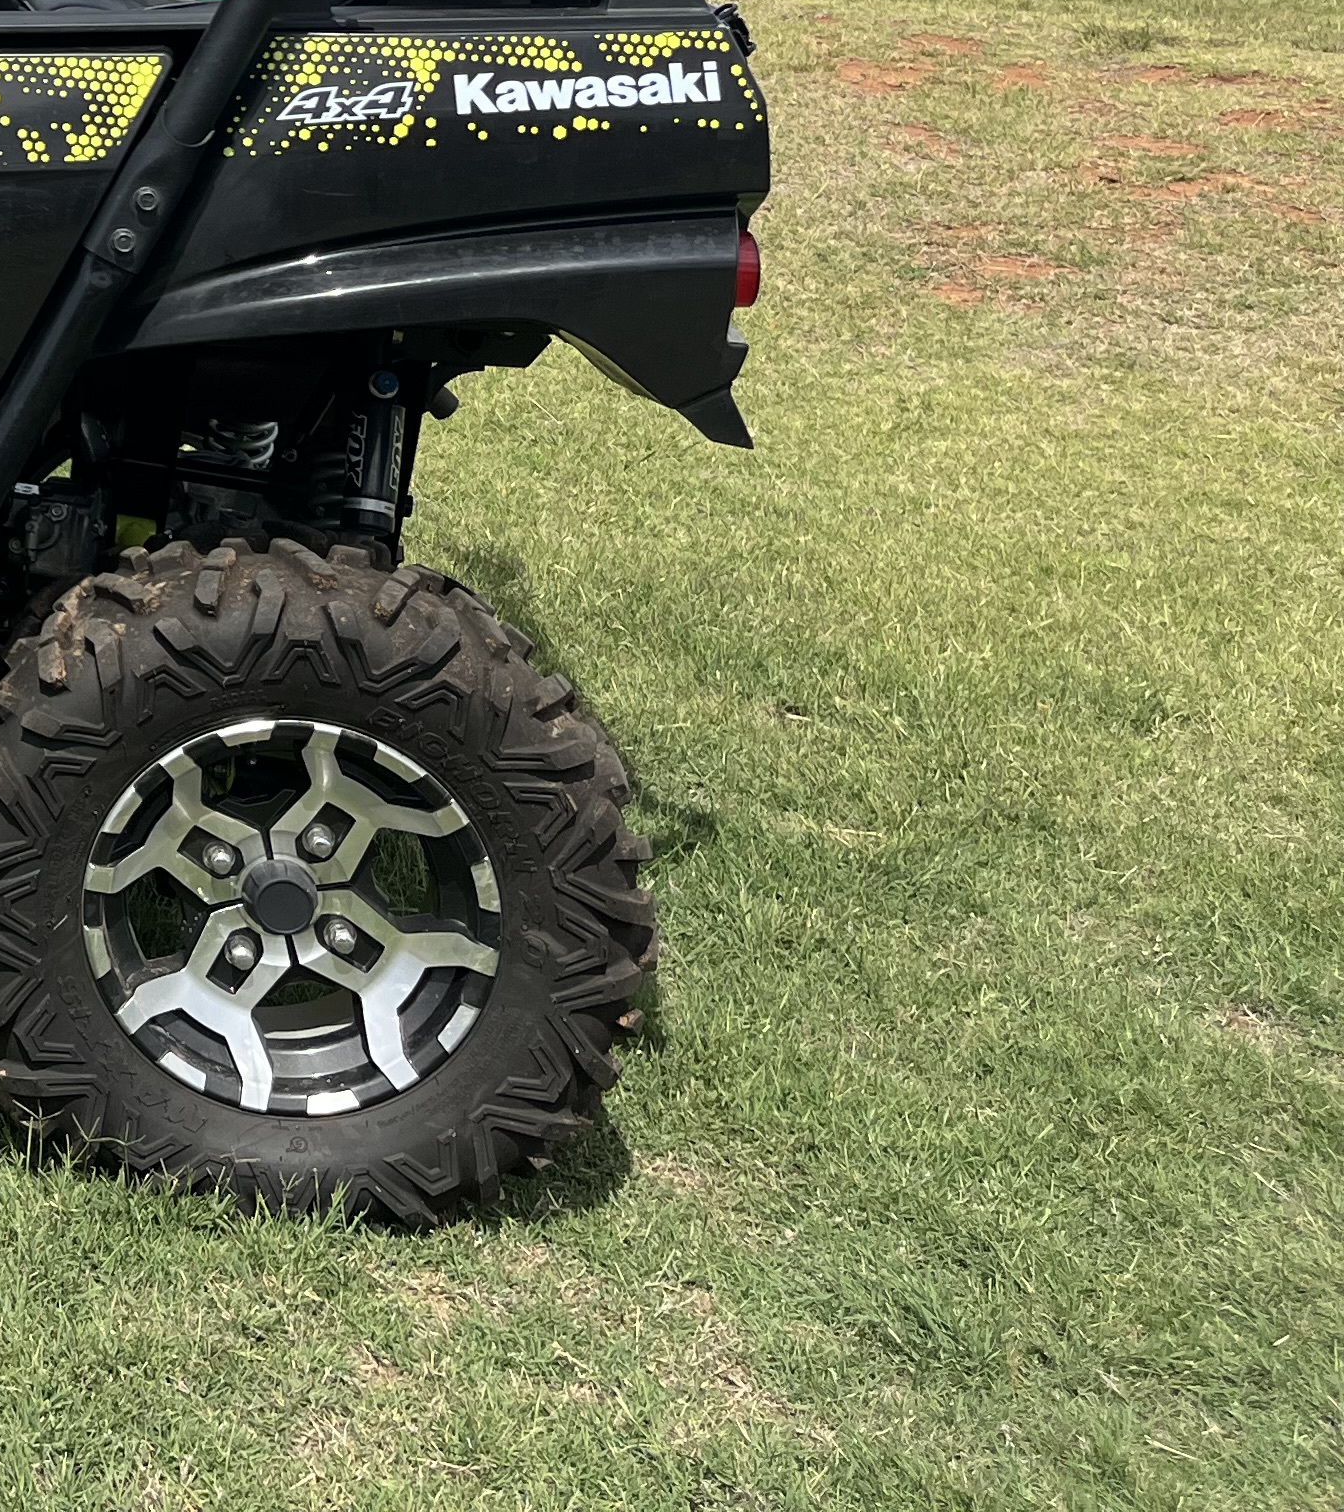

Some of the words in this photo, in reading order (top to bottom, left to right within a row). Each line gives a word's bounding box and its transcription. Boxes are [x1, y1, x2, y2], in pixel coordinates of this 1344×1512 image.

[276, 81, 414, 125] 4x4
[453, 61, 722, 116] Kawasaki
[342, 411, 368, 489] FOX
[365, 704, 540, 874] BIGHORN
